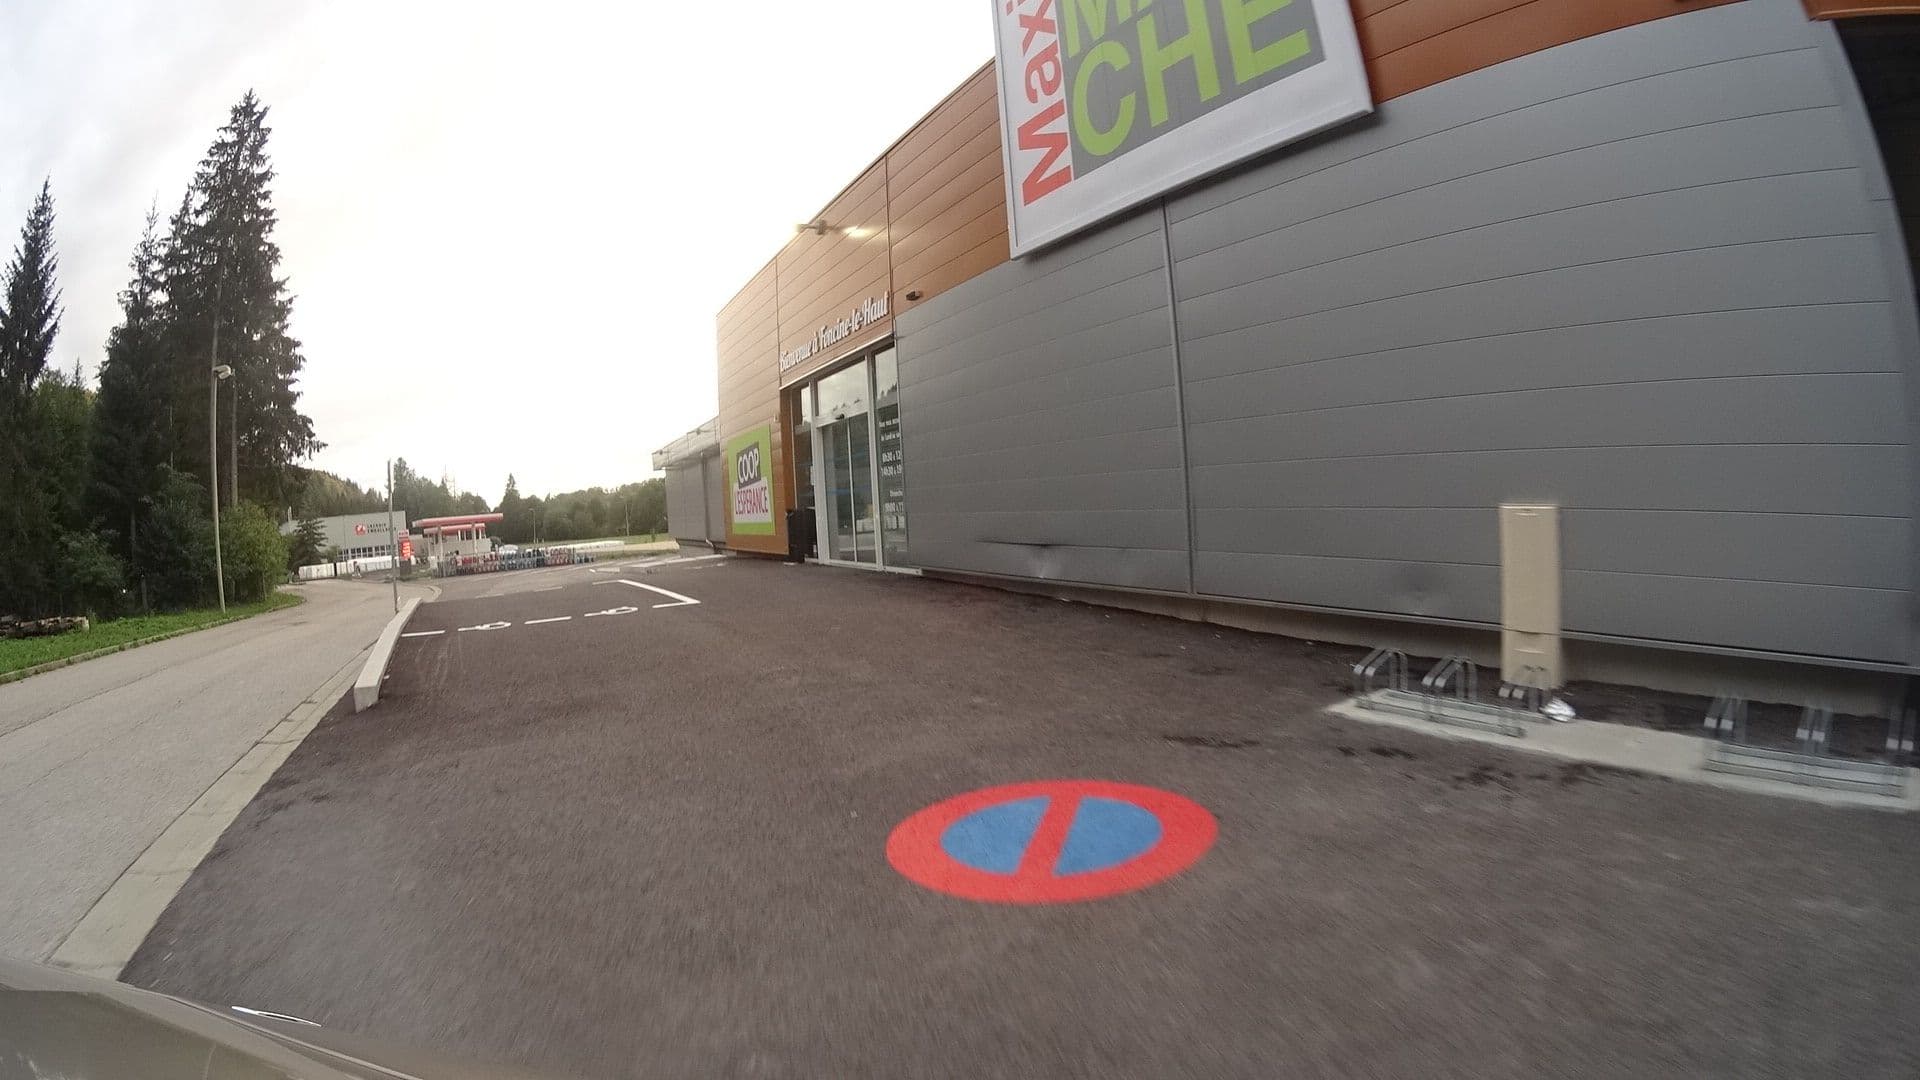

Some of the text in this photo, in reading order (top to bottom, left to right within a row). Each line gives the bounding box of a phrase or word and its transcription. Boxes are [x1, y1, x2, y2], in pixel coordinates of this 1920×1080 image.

[1060, 0, 1158, 57] M
[1073, 0, 1311, 156] CHE
[738, 448, 759, 484] COOP
